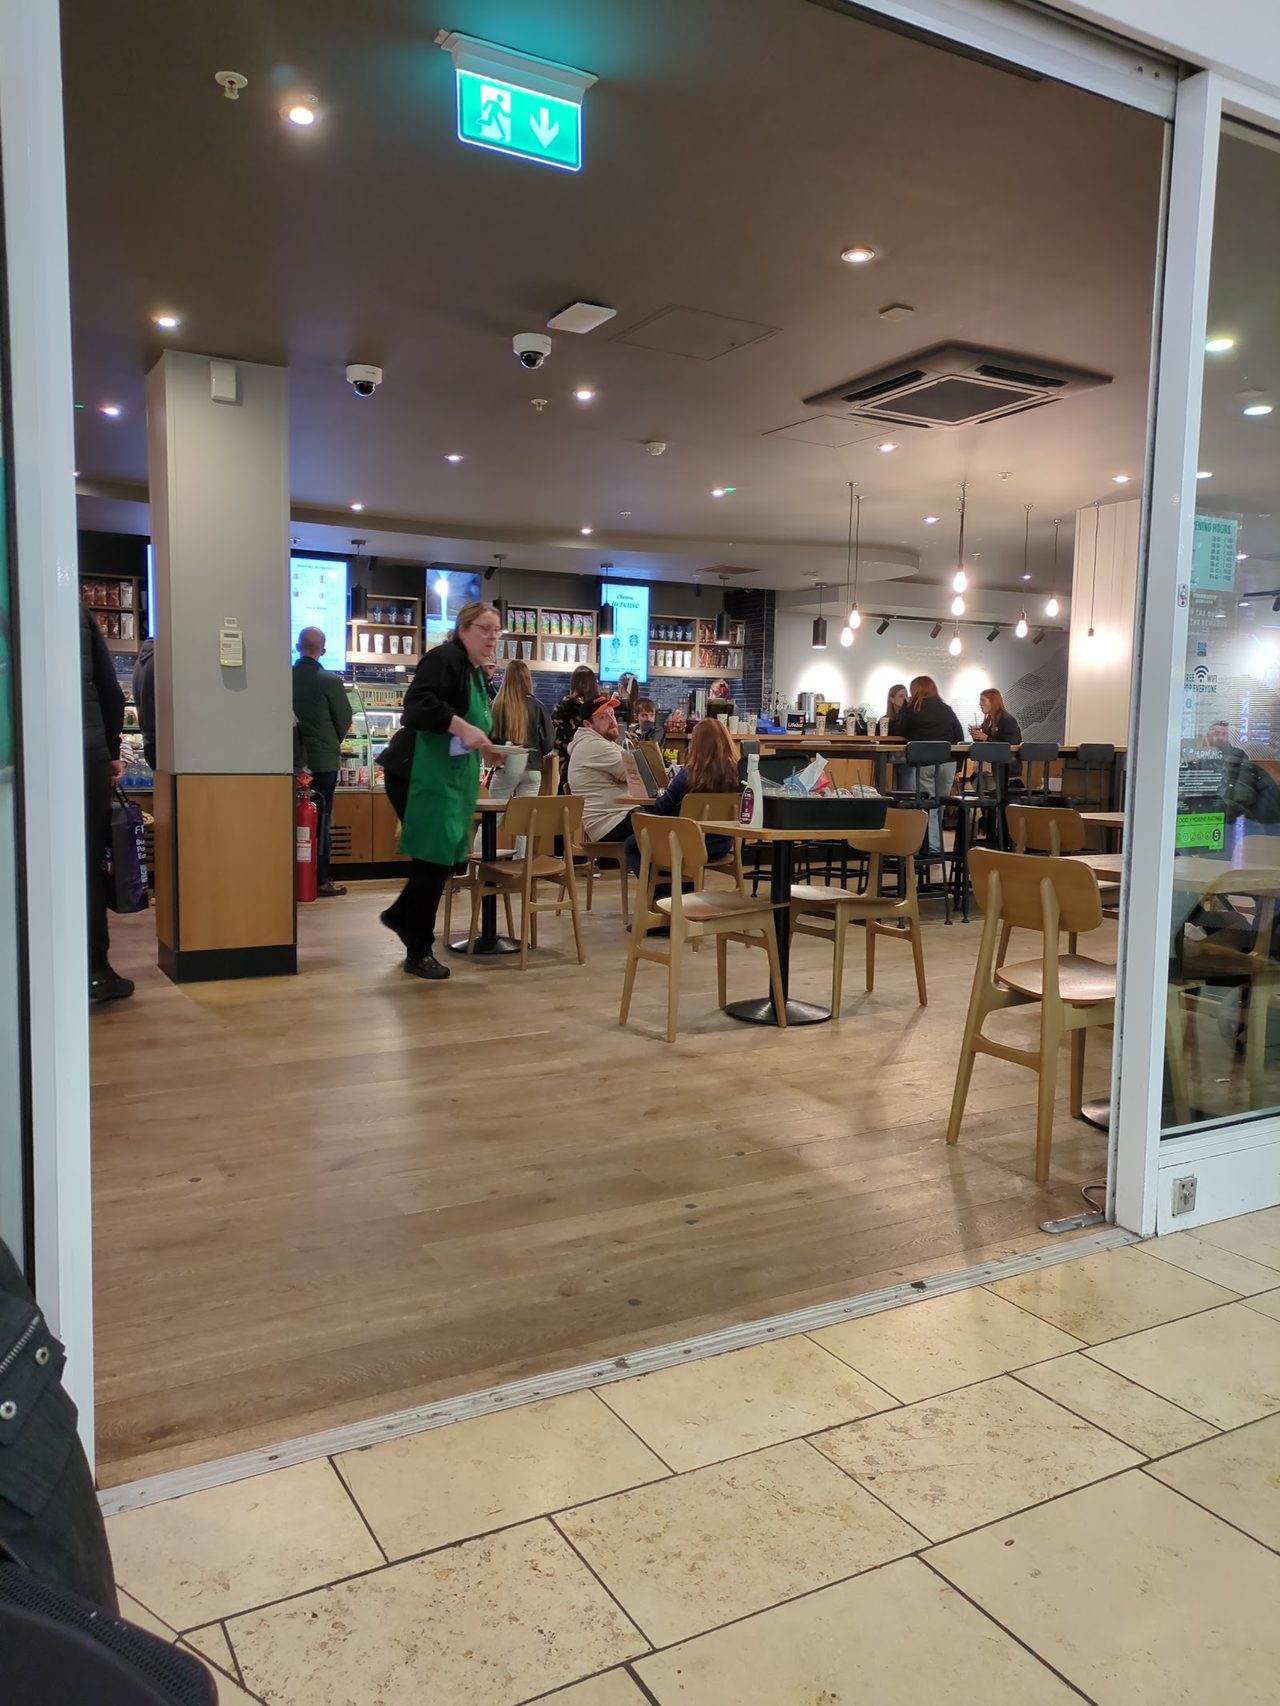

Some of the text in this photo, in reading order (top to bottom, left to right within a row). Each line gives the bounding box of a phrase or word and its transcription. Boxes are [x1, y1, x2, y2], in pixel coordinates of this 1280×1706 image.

[1194, 520, 1231, 535] ENING HOURS
[1184, 673, 1195, 682] REE
[1193, 684, 1217, 693] EVERYONE
[1194, 750, 1223, 760] ARNING
[1213, 830, 1220, 841] 5
